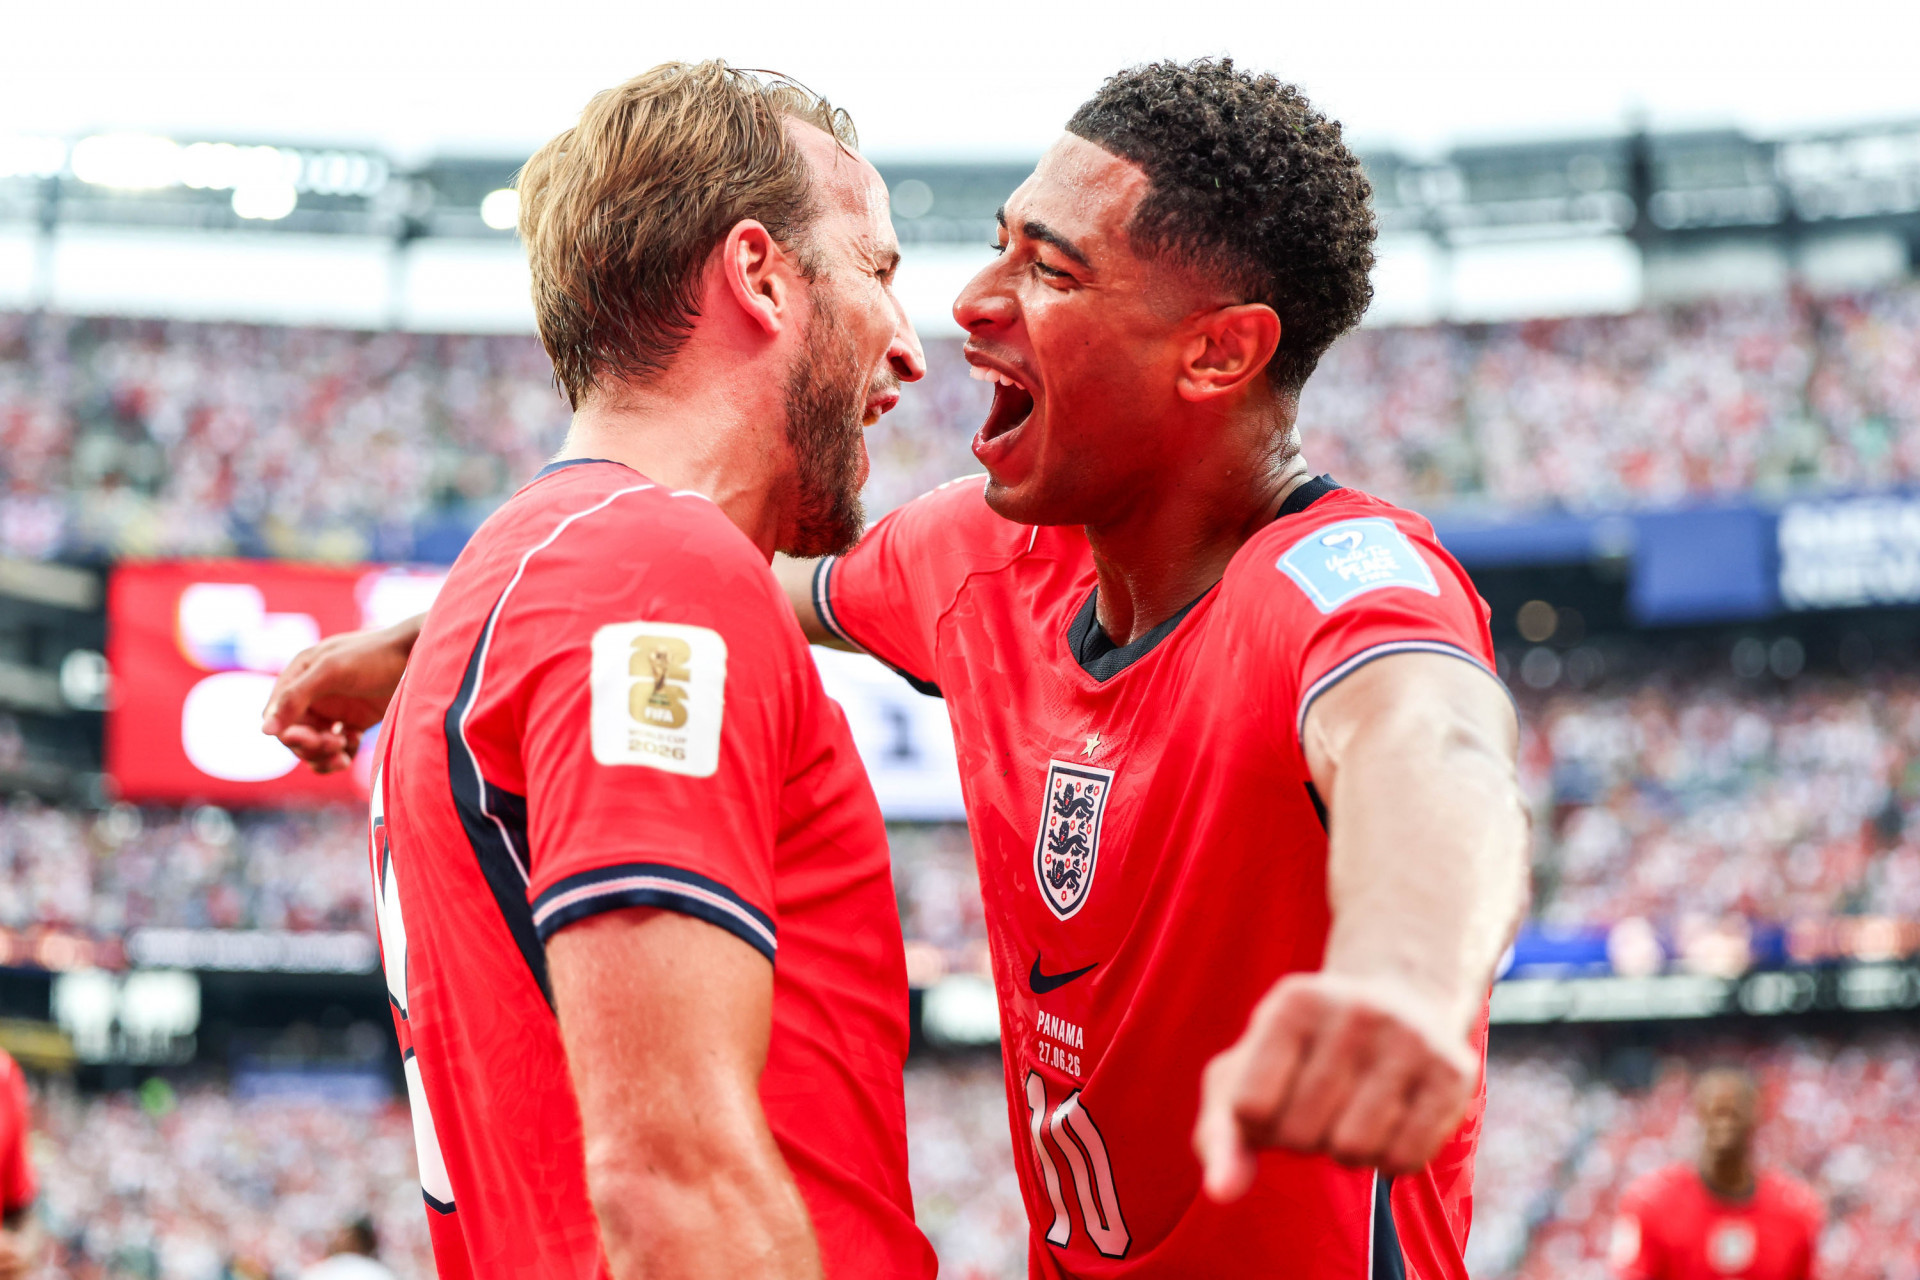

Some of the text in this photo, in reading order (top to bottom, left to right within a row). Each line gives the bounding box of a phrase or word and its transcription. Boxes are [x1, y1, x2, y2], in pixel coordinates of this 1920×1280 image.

[644, 706, 674, 723] FIFA
[628, 738, 686, 761] 2026
[1036, 1009, 1084, 1050] PANAMA
[1038, 1040, 1081, 1077] 27.06.26
[1025, 1068, 1133, 1261] 10
